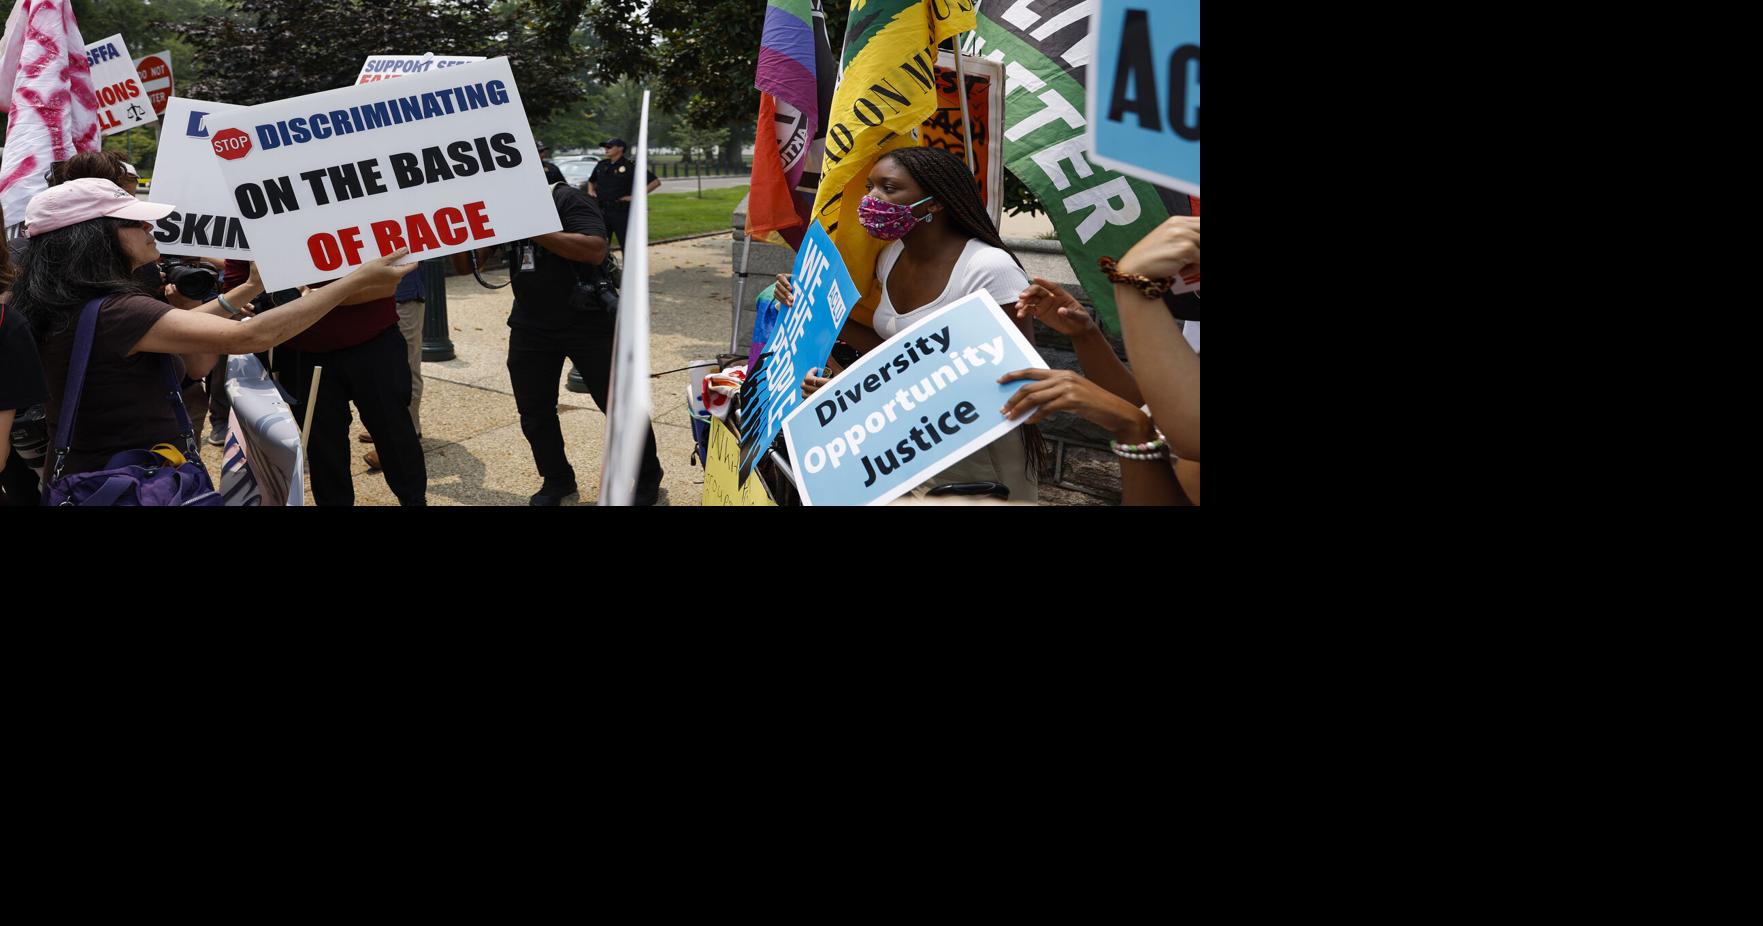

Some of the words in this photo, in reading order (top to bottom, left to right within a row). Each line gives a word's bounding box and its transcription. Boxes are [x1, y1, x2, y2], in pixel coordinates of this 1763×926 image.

[365, 59, 434, 74] SUPPORT
[853, 77, 912, 127] ON
[213, 136, 249, 153] STOP
[255, 79, 510, 151] DISCRIMINATING
[234, 175, 300, 220] ON
[301, 157, 388, 206] THE
[389, 132, 523, 190] BASIS
[307, 226, 365, 272] OF
[370, 200, 496, 258] RACE
[798, 237, 831, 306] WE
[765, 322, 797, 438] PEOPLE
[803, 335, 1005, 474] Opportunity
[815, 325, 951, 427] Diversity
[860, 400, 980, 488] Justice
